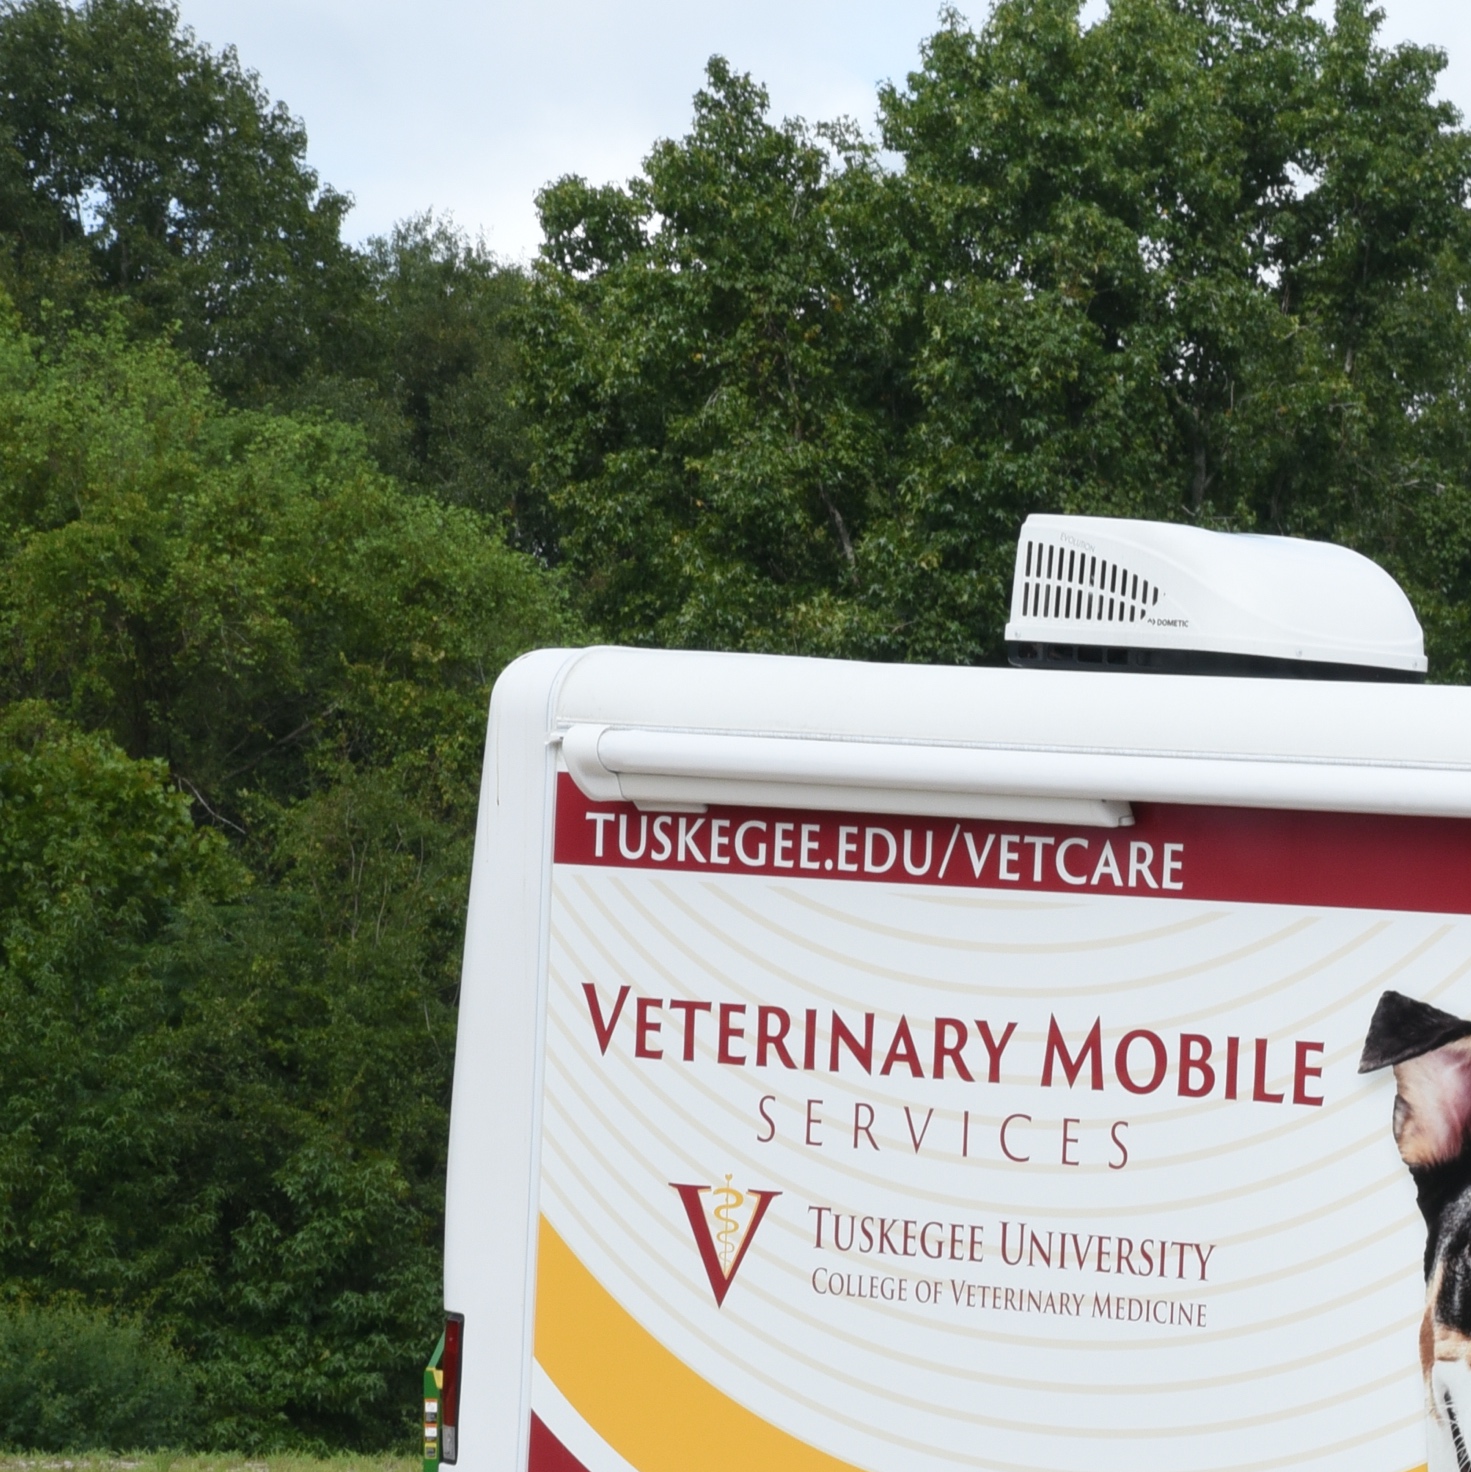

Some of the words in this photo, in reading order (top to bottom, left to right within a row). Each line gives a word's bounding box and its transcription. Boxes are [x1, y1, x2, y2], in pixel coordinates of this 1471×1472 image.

[1060, 531, 1095, 553] EVOLUTION
[1156, 618, 1189, 628] DOMETIC
[585, 810, 1185, 891] TUSKEGEE.EDU/VETCARE
[581, 982, 1019, 1084] VETERINARY
[1040, 1012, 1326, 1107] MOBILE
[755, 1094, 1131, 1170] SERVICES
[808, 1205, 984, 1264] TUSKEGEE
[999, 1222, 1217, 1282] UNIVERSITY
[811, 1266, 908, 1304] COLLEGE
[916, 1280, 943, 1306] OF
[950, 1279, 1085, 1317] VETERINARY
[1091, 1294, 1208, 1328] MEDICINE
